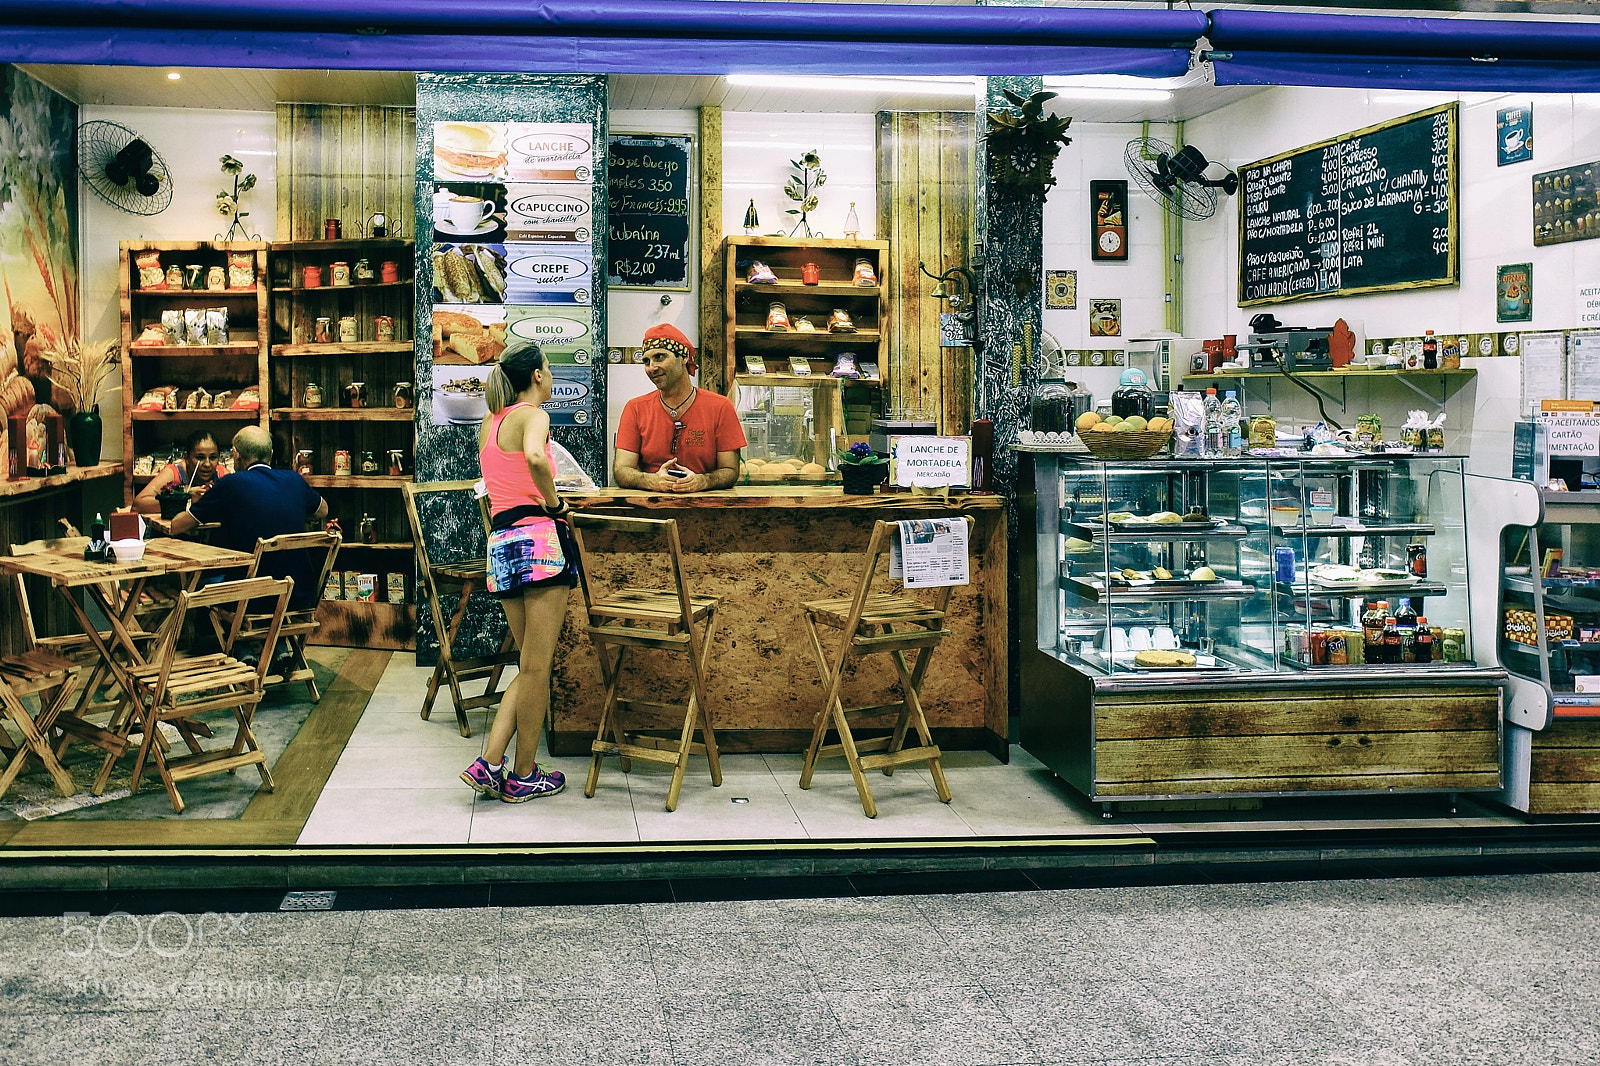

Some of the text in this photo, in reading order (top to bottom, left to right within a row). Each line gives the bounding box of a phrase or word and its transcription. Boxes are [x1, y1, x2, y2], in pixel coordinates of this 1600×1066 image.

[529, 142, 574, 151] LANCHE
[538, 151, 581, 162] mortadela
[518, 202, 583, 213] CAPUCCINO
[542, 215, 578, 223] chantilly
[1343, 256, 1363, 269] LATA
[532, 264, 569, 273] CREPE
[537, 275, 564, 285] suiço
[535, 326, 563, 334] BOLO
[540, 336, 574, 347] pedaços
[551, 387, 580, 396] HADA
[1555, 418, 1600, 427] ACEITAMOS
[1552, 430, 1582, 439] CARTÃO
[1549, 442, 1595, 452] IMENTAÇÃO
[907, 459, 962, 467] MORTADELA
